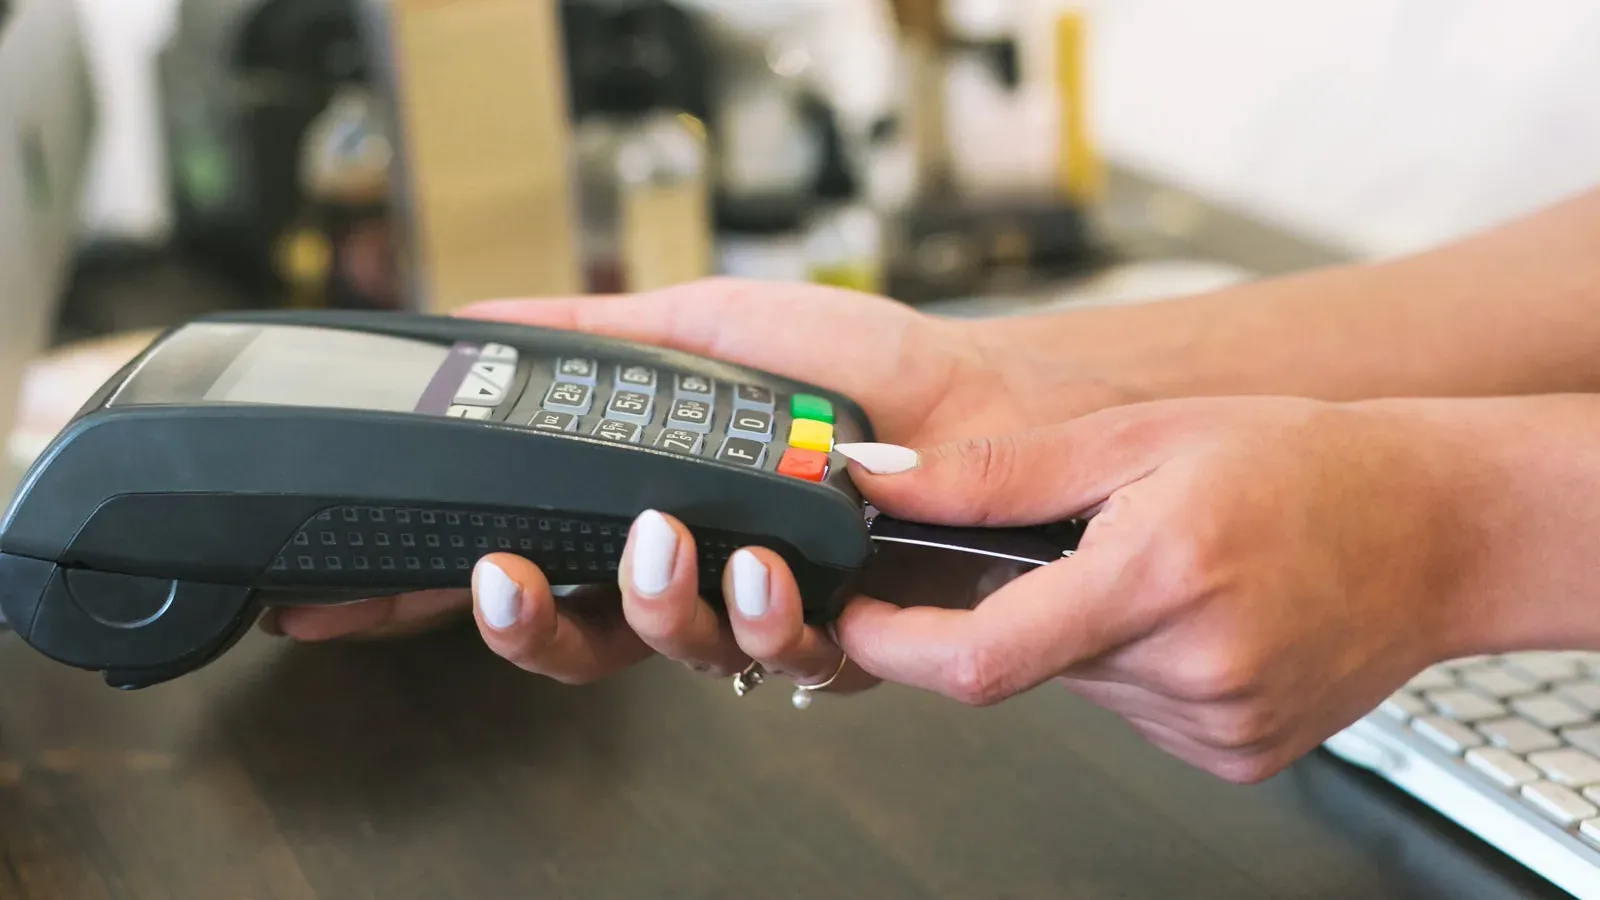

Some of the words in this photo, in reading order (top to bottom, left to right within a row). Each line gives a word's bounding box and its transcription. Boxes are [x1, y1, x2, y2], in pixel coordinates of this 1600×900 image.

[553, 391, 580, 402] 2
[616, 401, 642, 410] 5
[677, 408, 703, 419] 8
[600, 430, 627, 440] 4
[663, 439, 690, 449] 7
[727, 448, 753, 460] F
